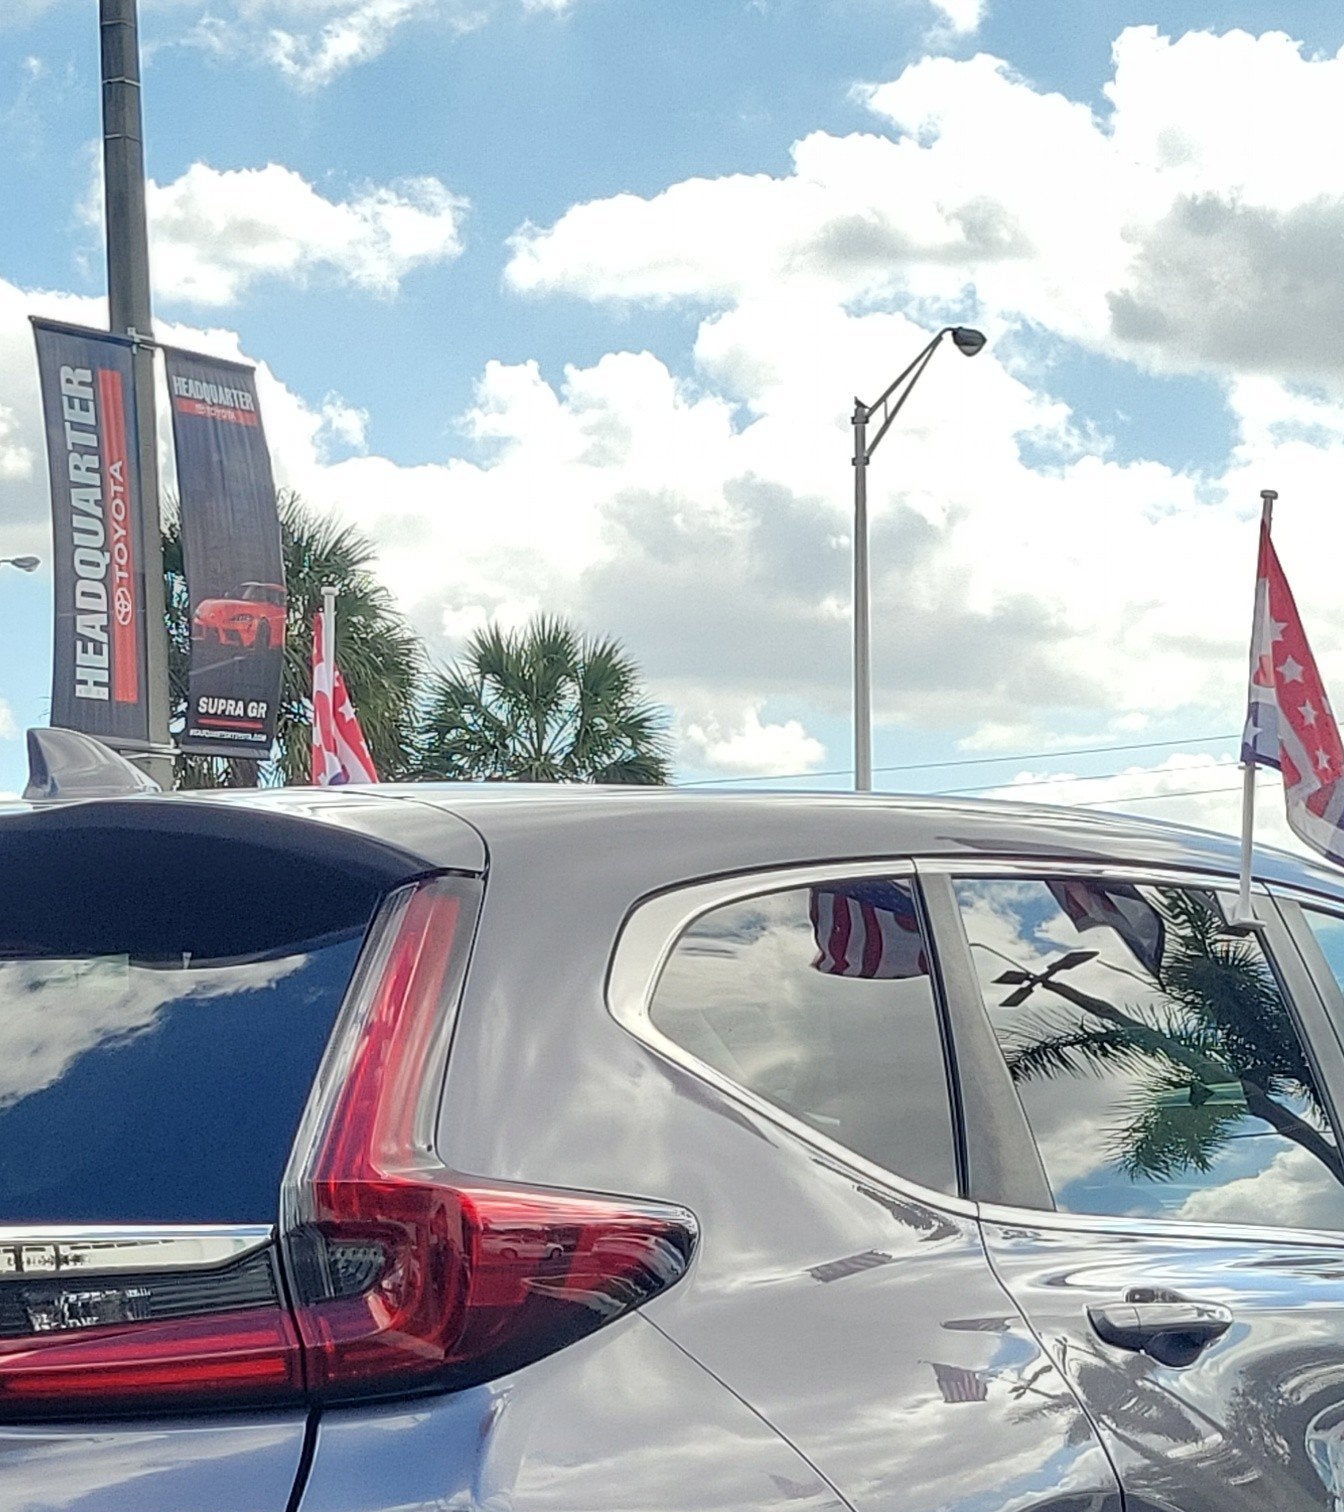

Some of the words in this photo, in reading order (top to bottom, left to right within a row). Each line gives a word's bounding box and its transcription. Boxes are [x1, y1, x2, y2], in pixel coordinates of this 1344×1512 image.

[172, 375, 255, 412] HEADQUARTER
[60, 365, 110, 701] HEADQUARTER
[109, 460, 131, 585] TOYOTA
[197, 696, 244, 717] SUPRA
[247, 701, 268, 718] GR
